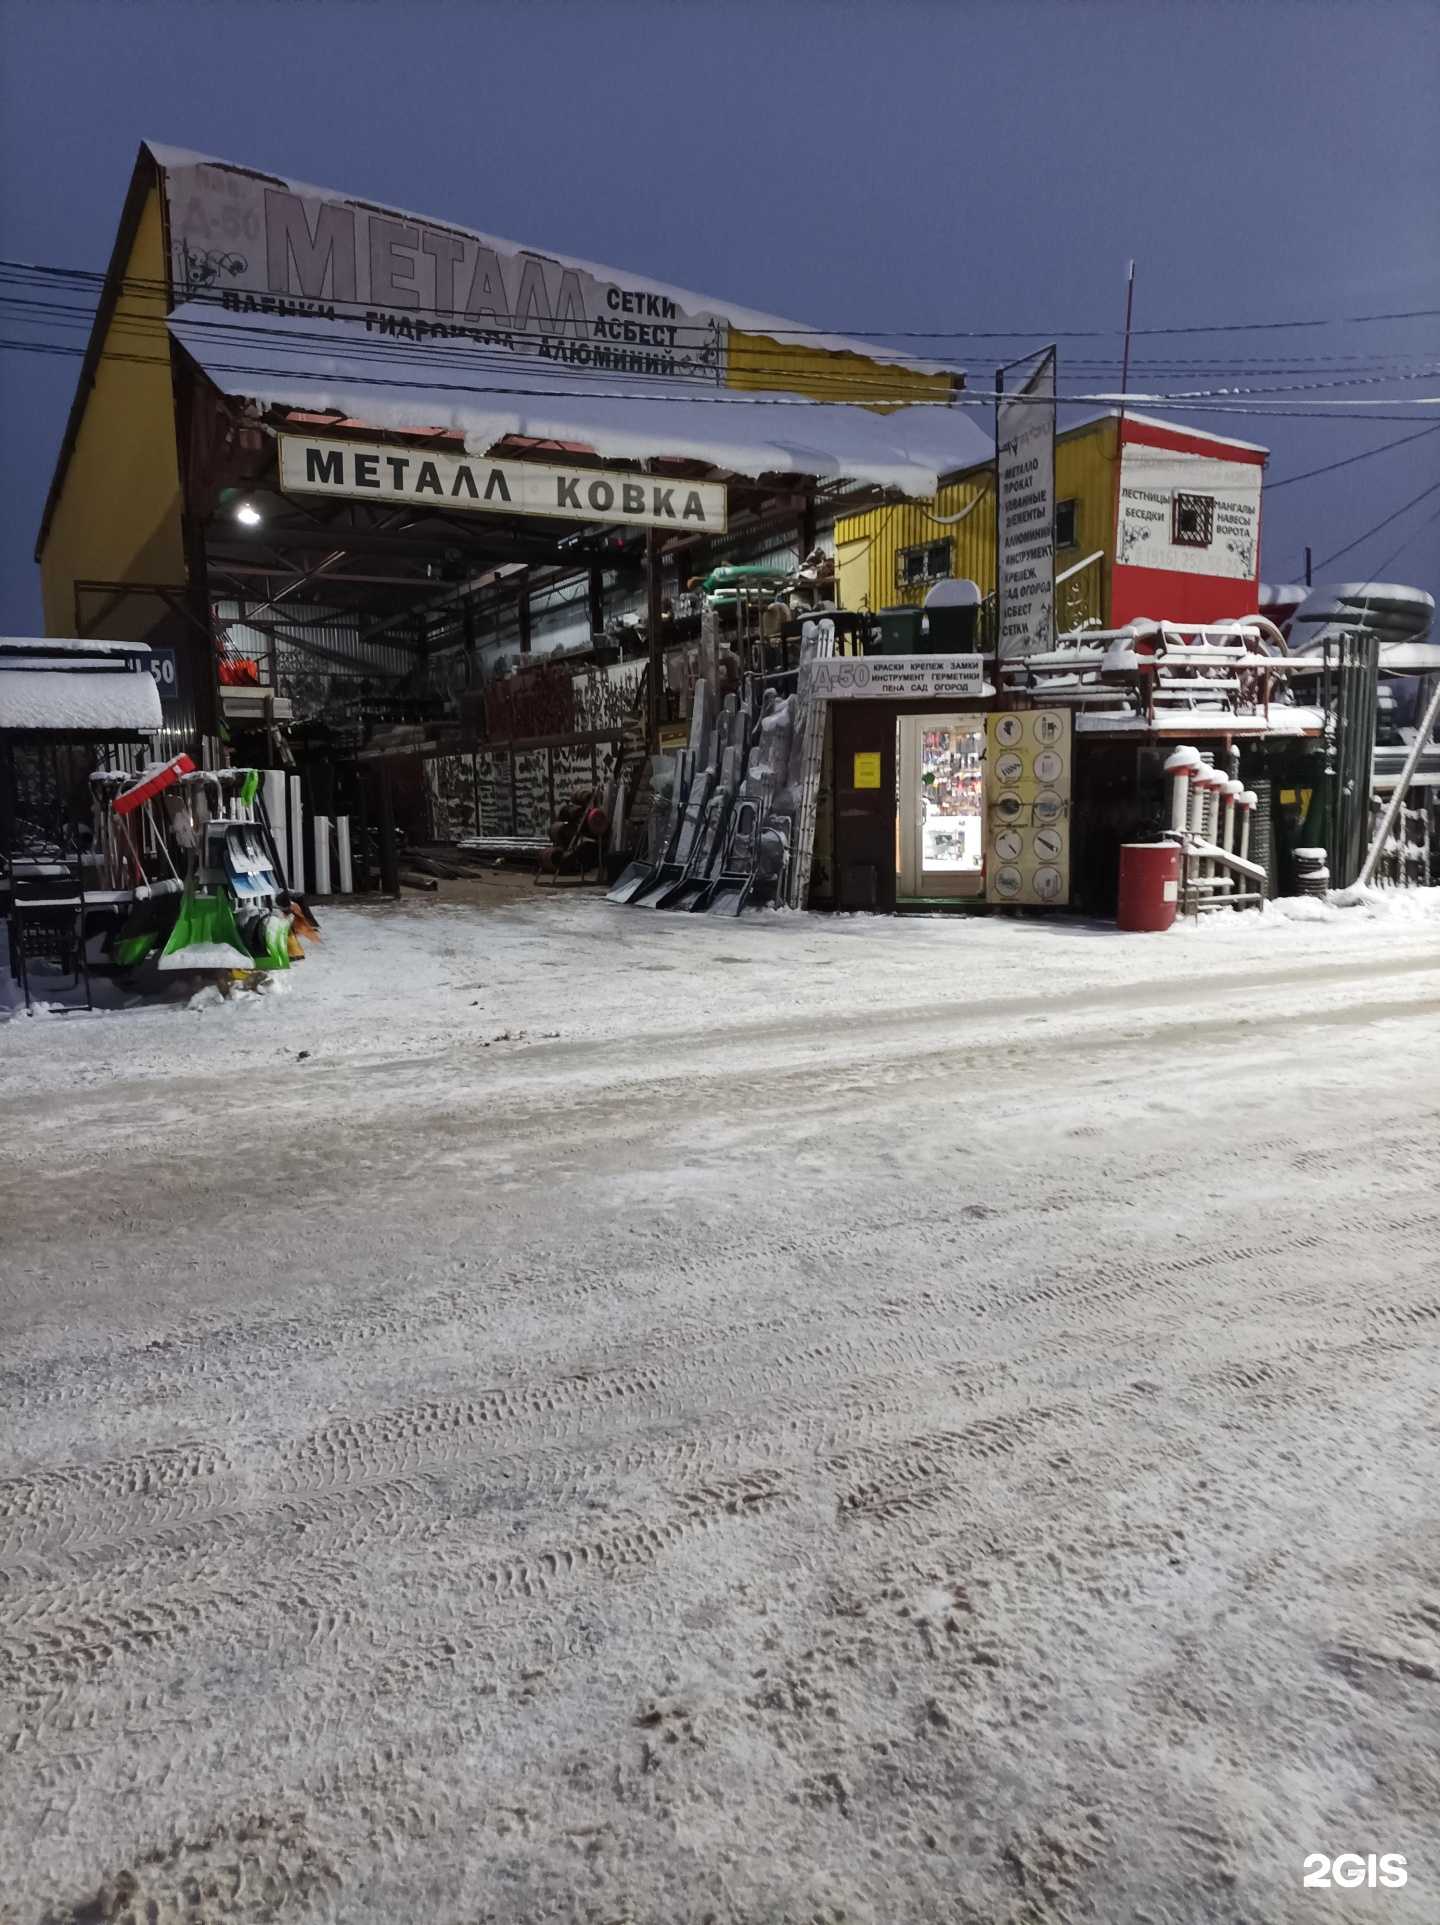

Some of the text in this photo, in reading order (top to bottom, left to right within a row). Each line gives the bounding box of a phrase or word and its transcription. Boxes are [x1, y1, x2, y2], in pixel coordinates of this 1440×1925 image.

[264, 187, 590, 340] МЕТАЛЛ
[606, 288, 677, 320] СЕТКИ
[594, 315, 678, 346] АСБЕСТ
[538, 335, 675, 376] АЛЮМИНИЙ
[305, 448, 706, 522] МЕТАЛЛ КОВКА
[1122, 487, 1170, 505] ЛЕСТНИЦЫ
[1125, 508, 1165, 522] БЕСЕДКИ
[1217, 513, 1251, 526] НАВЕСЫ
[1216, 525, 1250, 537] ВОРОТА
[873, 662, 979, 672] КРАСКИ КРЕПЕЖ ЗАМКИ
[871, 673, 980, 682] ИНСТРУМЕНТ ГЕРМЕТИКИ
[882, 683, 969, 692] ПЕНА САД ОГОРОД
